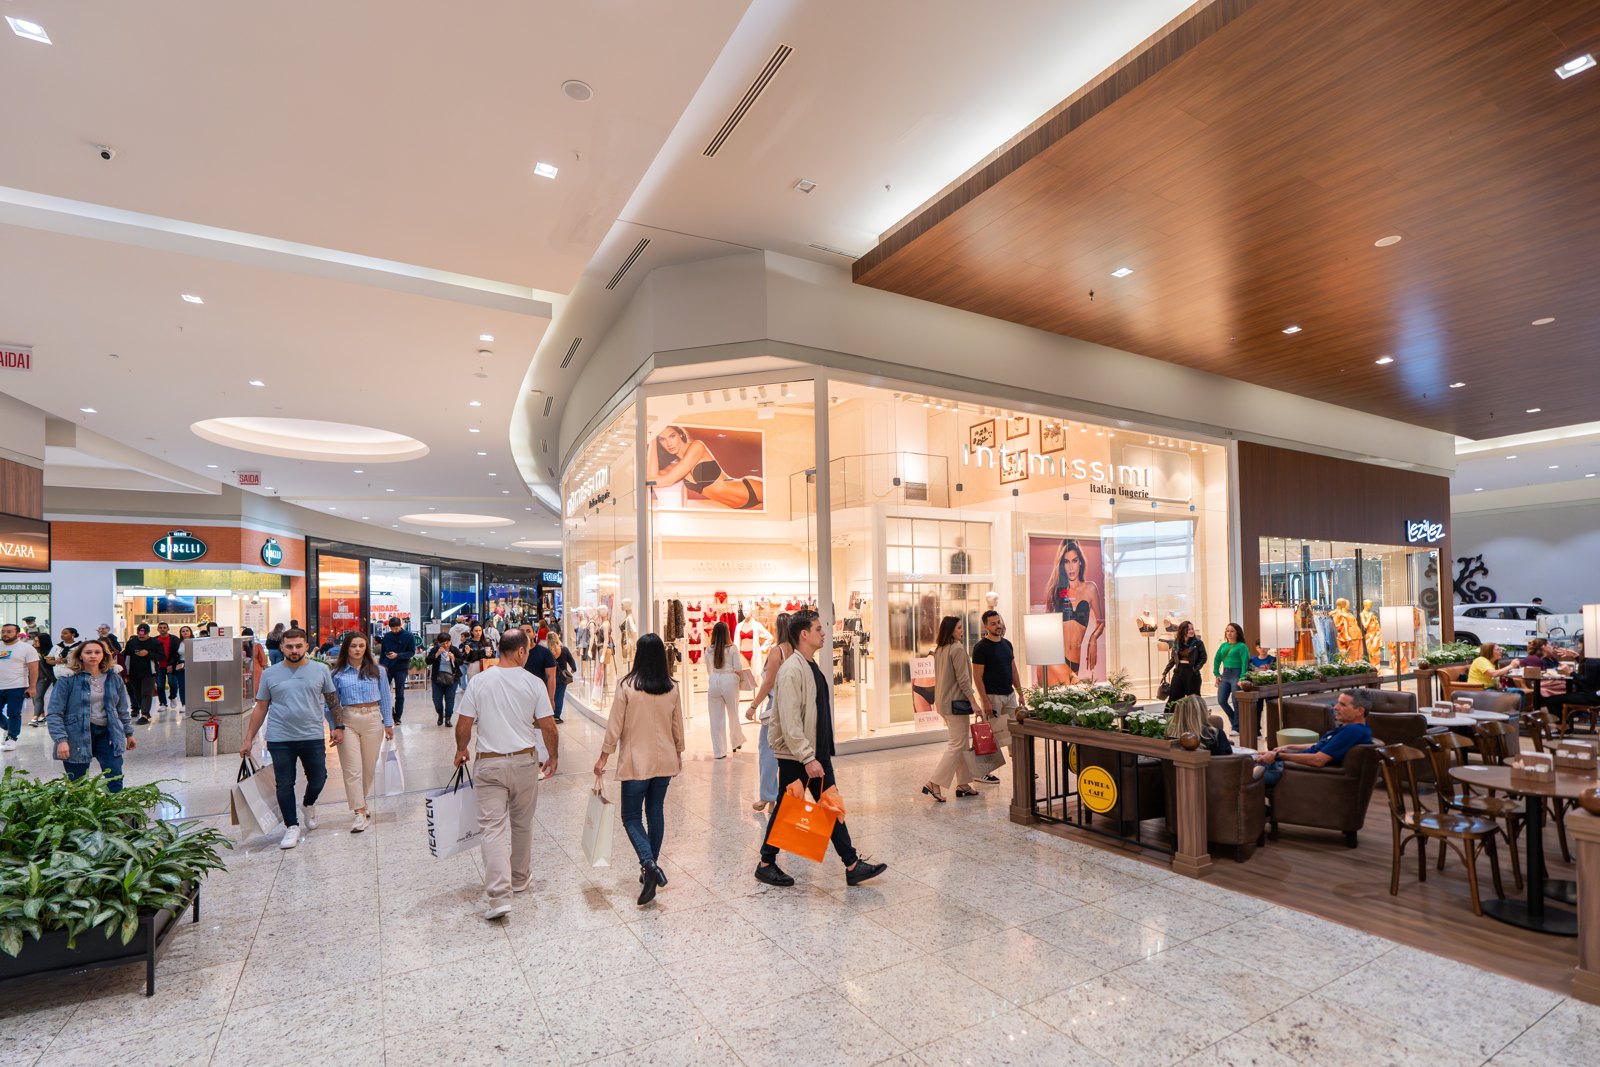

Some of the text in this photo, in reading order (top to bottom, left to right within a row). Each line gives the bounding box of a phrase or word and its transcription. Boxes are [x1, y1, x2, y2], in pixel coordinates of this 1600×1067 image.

[963, 443, 1152, 488] intimissimi
[1090, 483, 1150, 499] Italian lingerie
[160, 543, 200, 553] BORELLI
[378, 612, 386, 620] DE
[218, 627, 225, 637] E
[425, 798, 438, 858] HEAVEN
